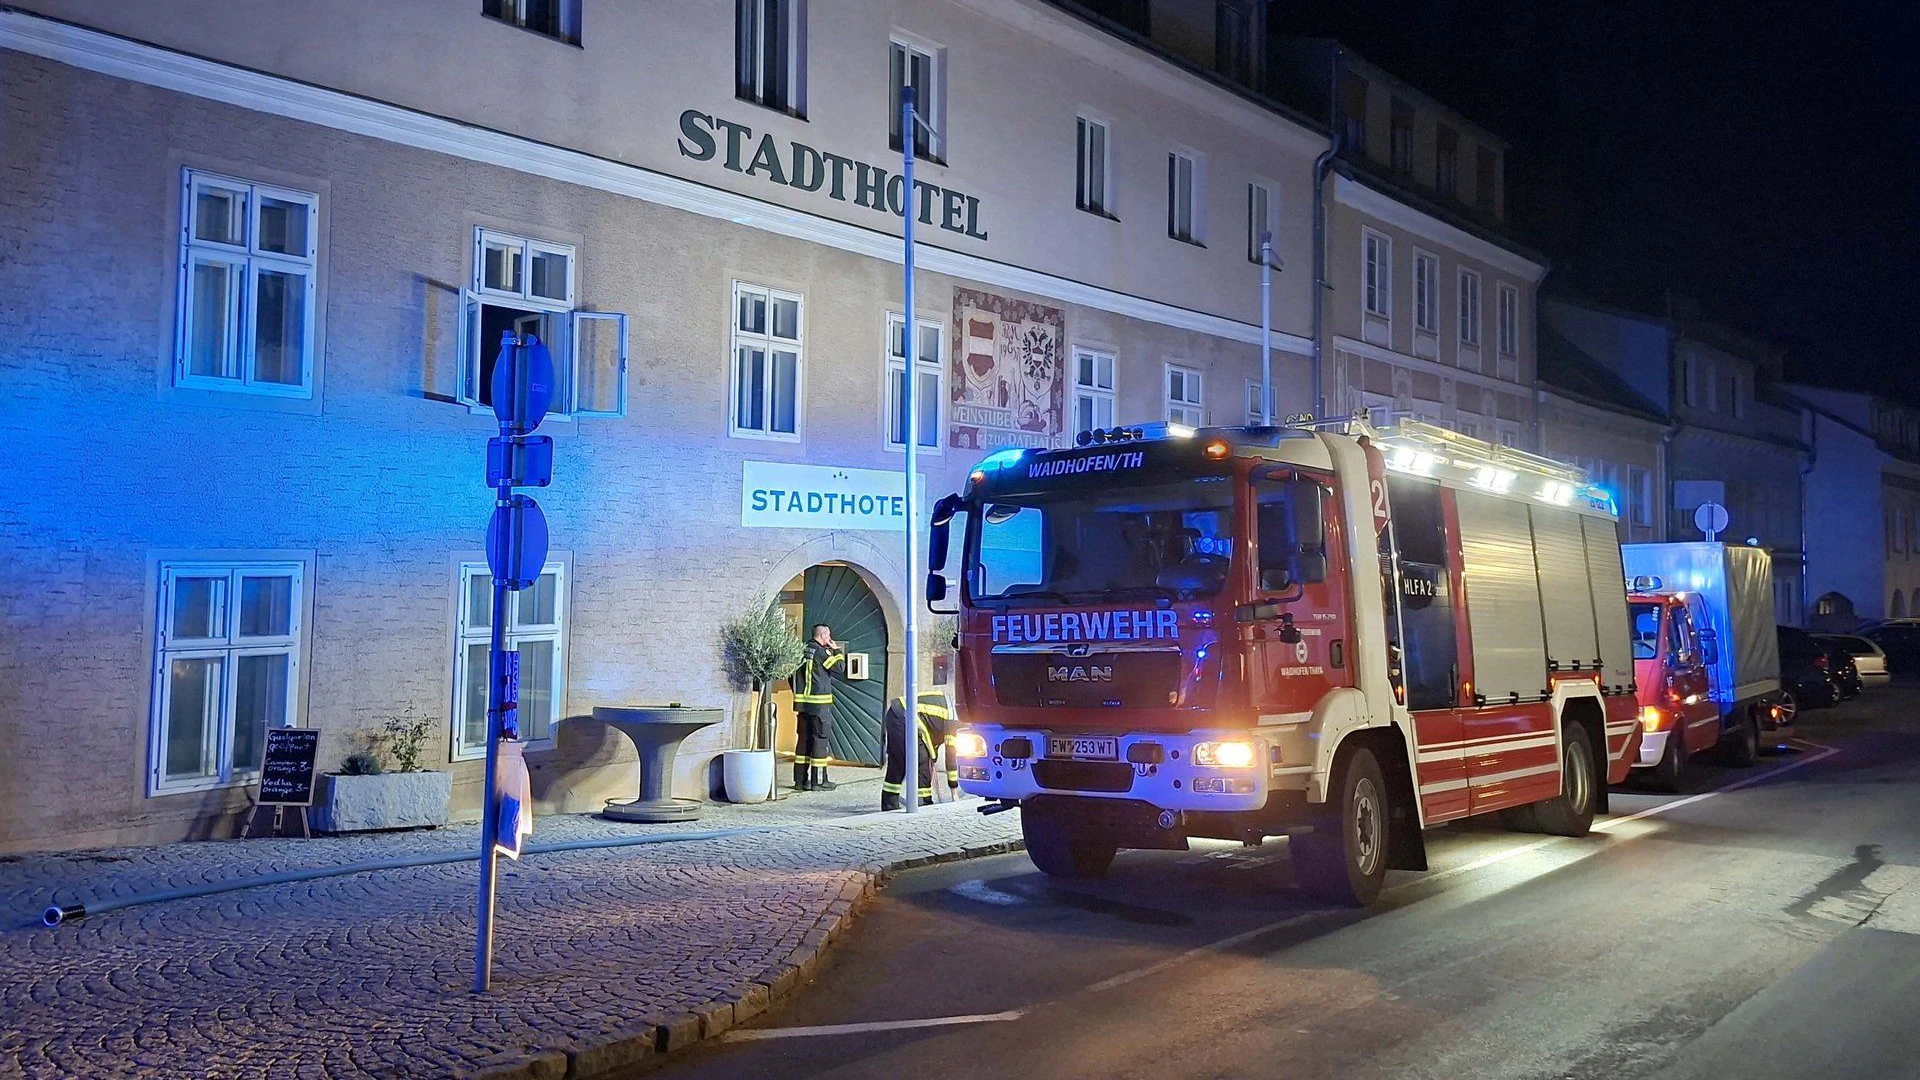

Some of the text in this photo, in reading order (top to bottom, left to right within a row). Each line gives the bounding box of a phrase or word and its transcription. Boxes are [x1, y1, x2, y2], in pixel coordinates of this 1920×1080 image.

[677, 109, 988, 241] STADTHOTEL
[953, 406, 1011, 427] WEINSTUBE
[1029, 452, 1144, 477] WAIDHOFEN/TH
[752, 489, 918, 516] STADTHOTE
[1372, 480, 1386, 517] 2
[1403, 578, 1432, 596] HLFA 2
[992, 609, 1179, 642] FEUERWEHR
[1048, 666, 1113, 682] MAN
[1074, 740, 1095, 754] 253
[1097, 741, 1112, 755] WT
